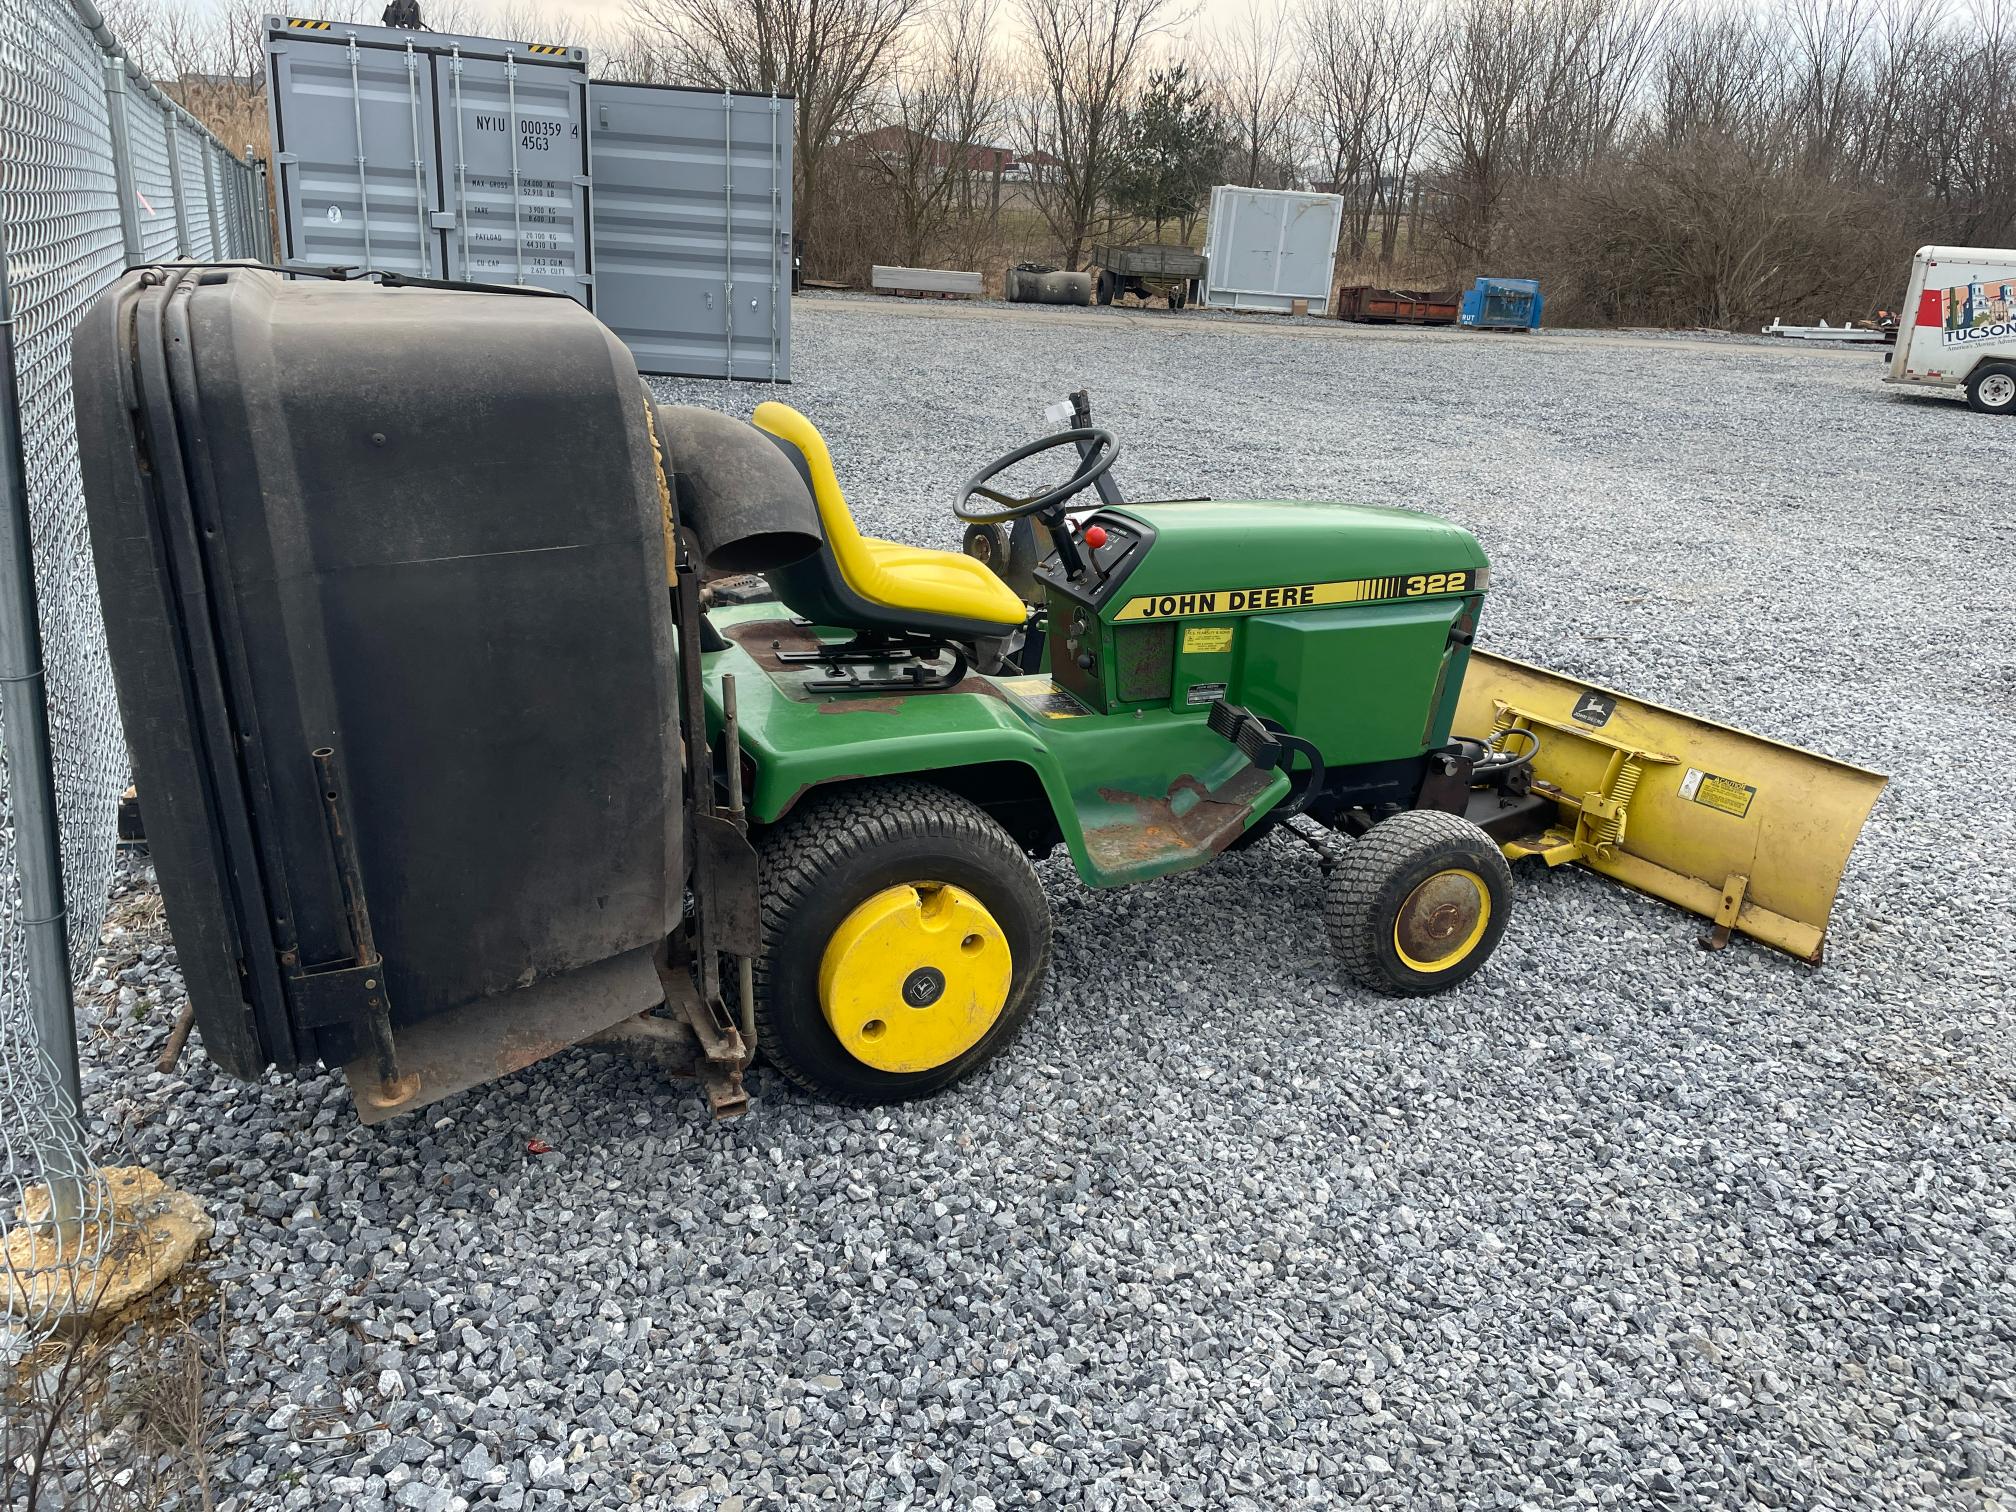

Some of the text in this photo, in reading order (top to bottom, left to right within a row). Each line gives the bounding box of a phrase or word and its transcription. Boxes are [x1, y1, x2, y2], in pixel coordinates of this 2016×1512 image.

[476, 115, 578, 139] NYIU 000359 4
[521, 136, 549, 151] 45G3
[472, 180, 485, 188] MAX
[489, 181, 508, 189] GROSS
[546, 181, 555, 189] KG
[547, 189, 555, 197] LB
[474, 206, 489, 214] TARE
[548, 207, 556, 215] KG
[548, 216, 556, 224] LB
[475, 232, 502, 241] PAYLOAD
[549, 233, 557, 241] KG
[549, 241, 557, 249] LB
[1945, 324, 2016, 342] TUCSON
[1406, 572, 1466, 596] 322
[1142, 585, 1316, 617] JOHN DEERE
